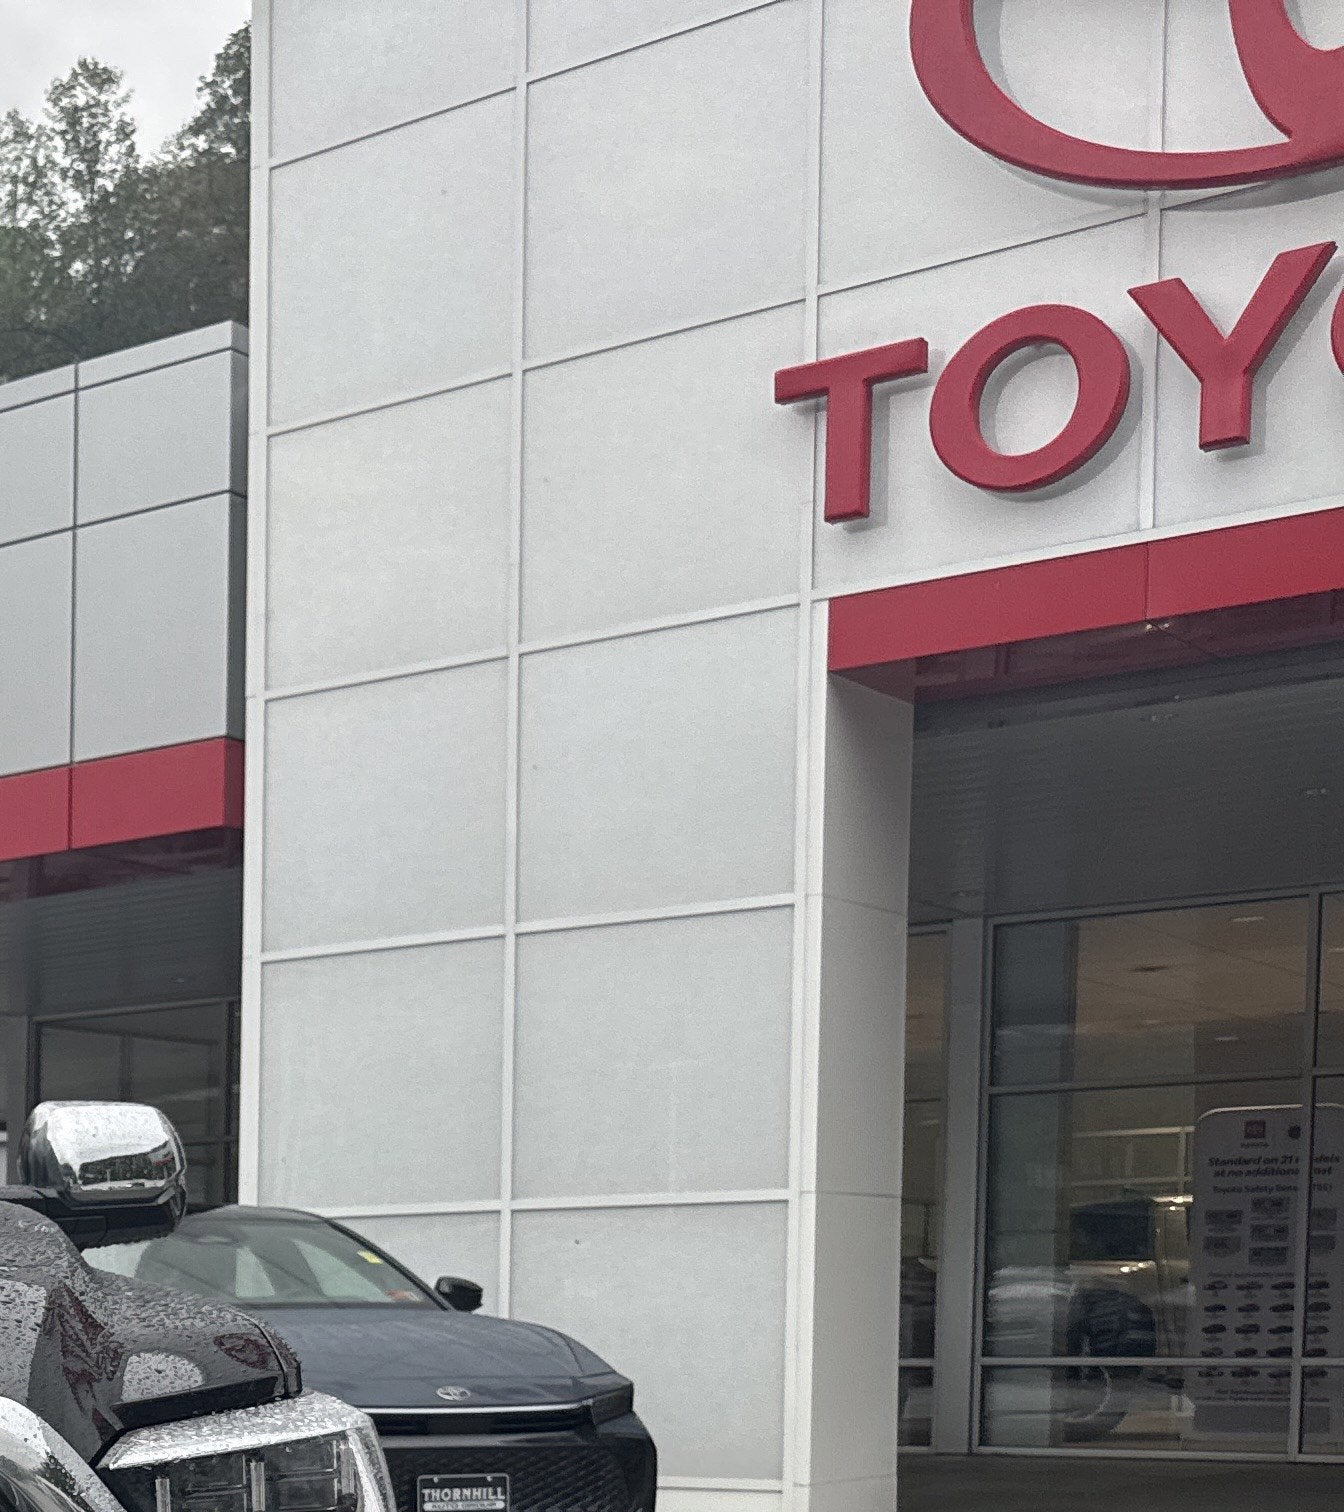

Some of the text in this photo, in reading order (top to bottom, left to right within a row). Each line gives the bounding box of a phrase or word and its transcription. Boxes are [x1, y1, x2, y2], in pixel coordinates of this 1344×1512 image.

[775, 241, 1344, 525] TOY
[1208, 1156, 1262, 1167] Standard
[1245, 1167, 1302, 1177] additiona
[421, 1487, 506, 1502] THORNHILL
